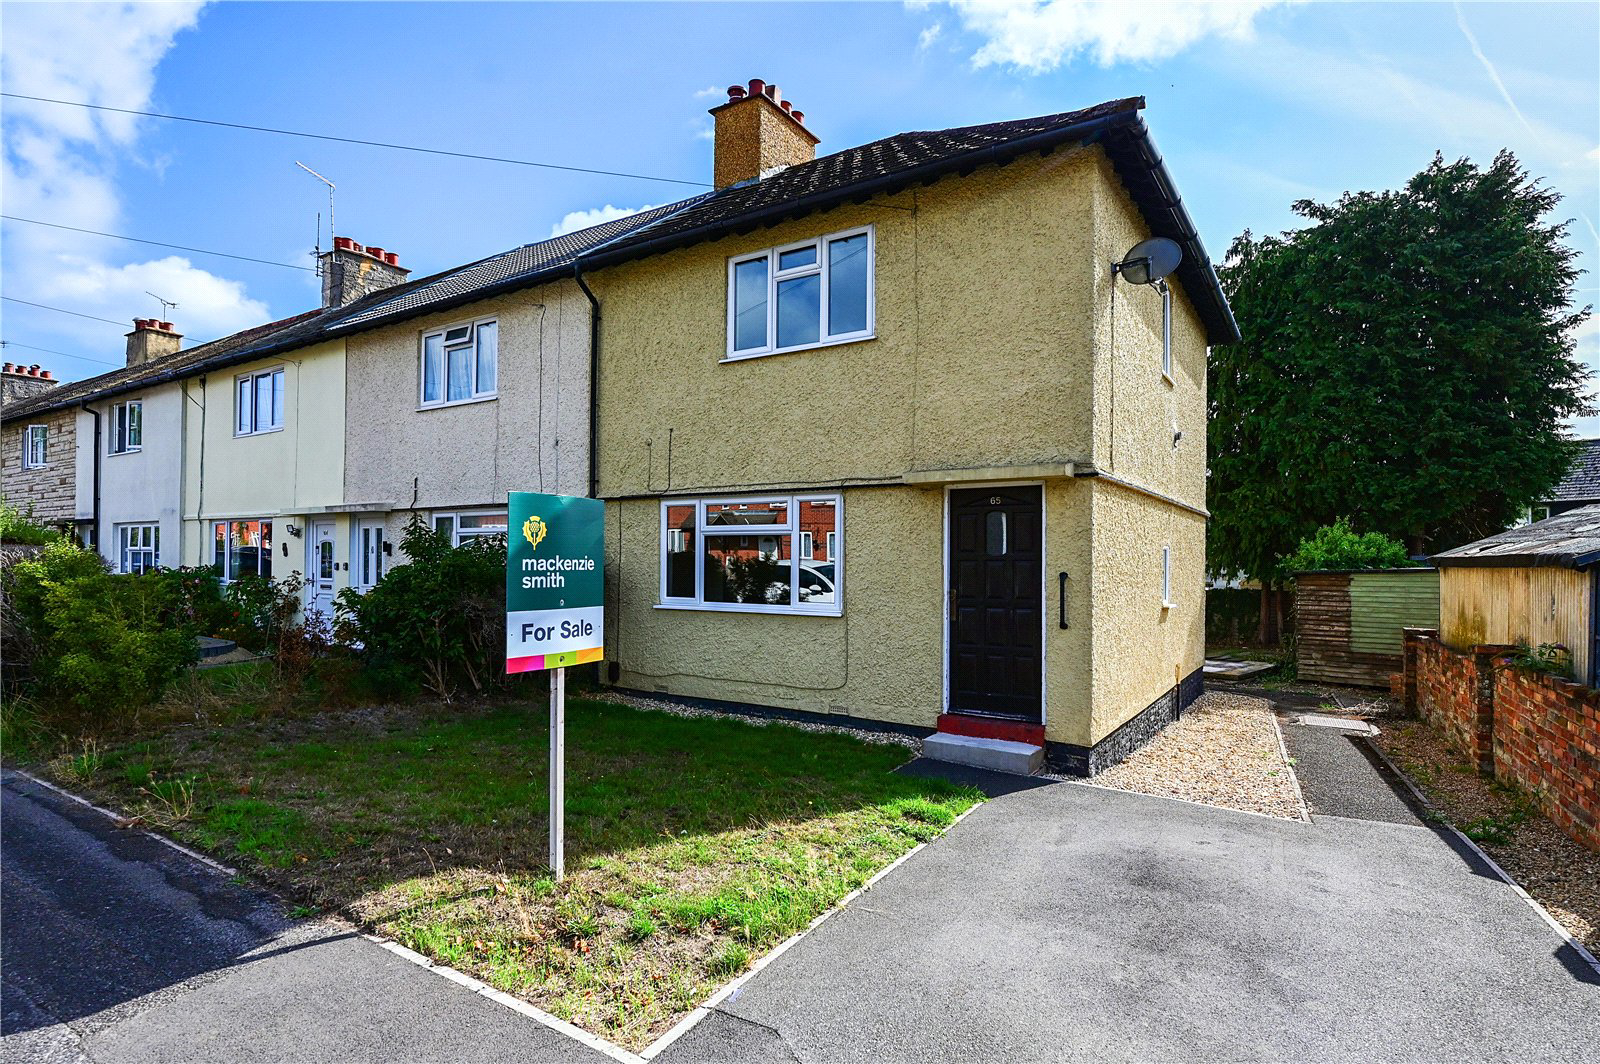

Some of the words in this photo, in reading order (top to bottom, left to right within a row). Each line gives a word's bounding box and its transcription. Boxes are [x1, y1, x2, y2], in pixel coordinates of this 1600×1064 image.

[522, 555, 595, 571] mackenzie
[522, 572, 565, 588] smith
[522, 623, 555, 642] For
[560, 619, 593, 639] Sale
